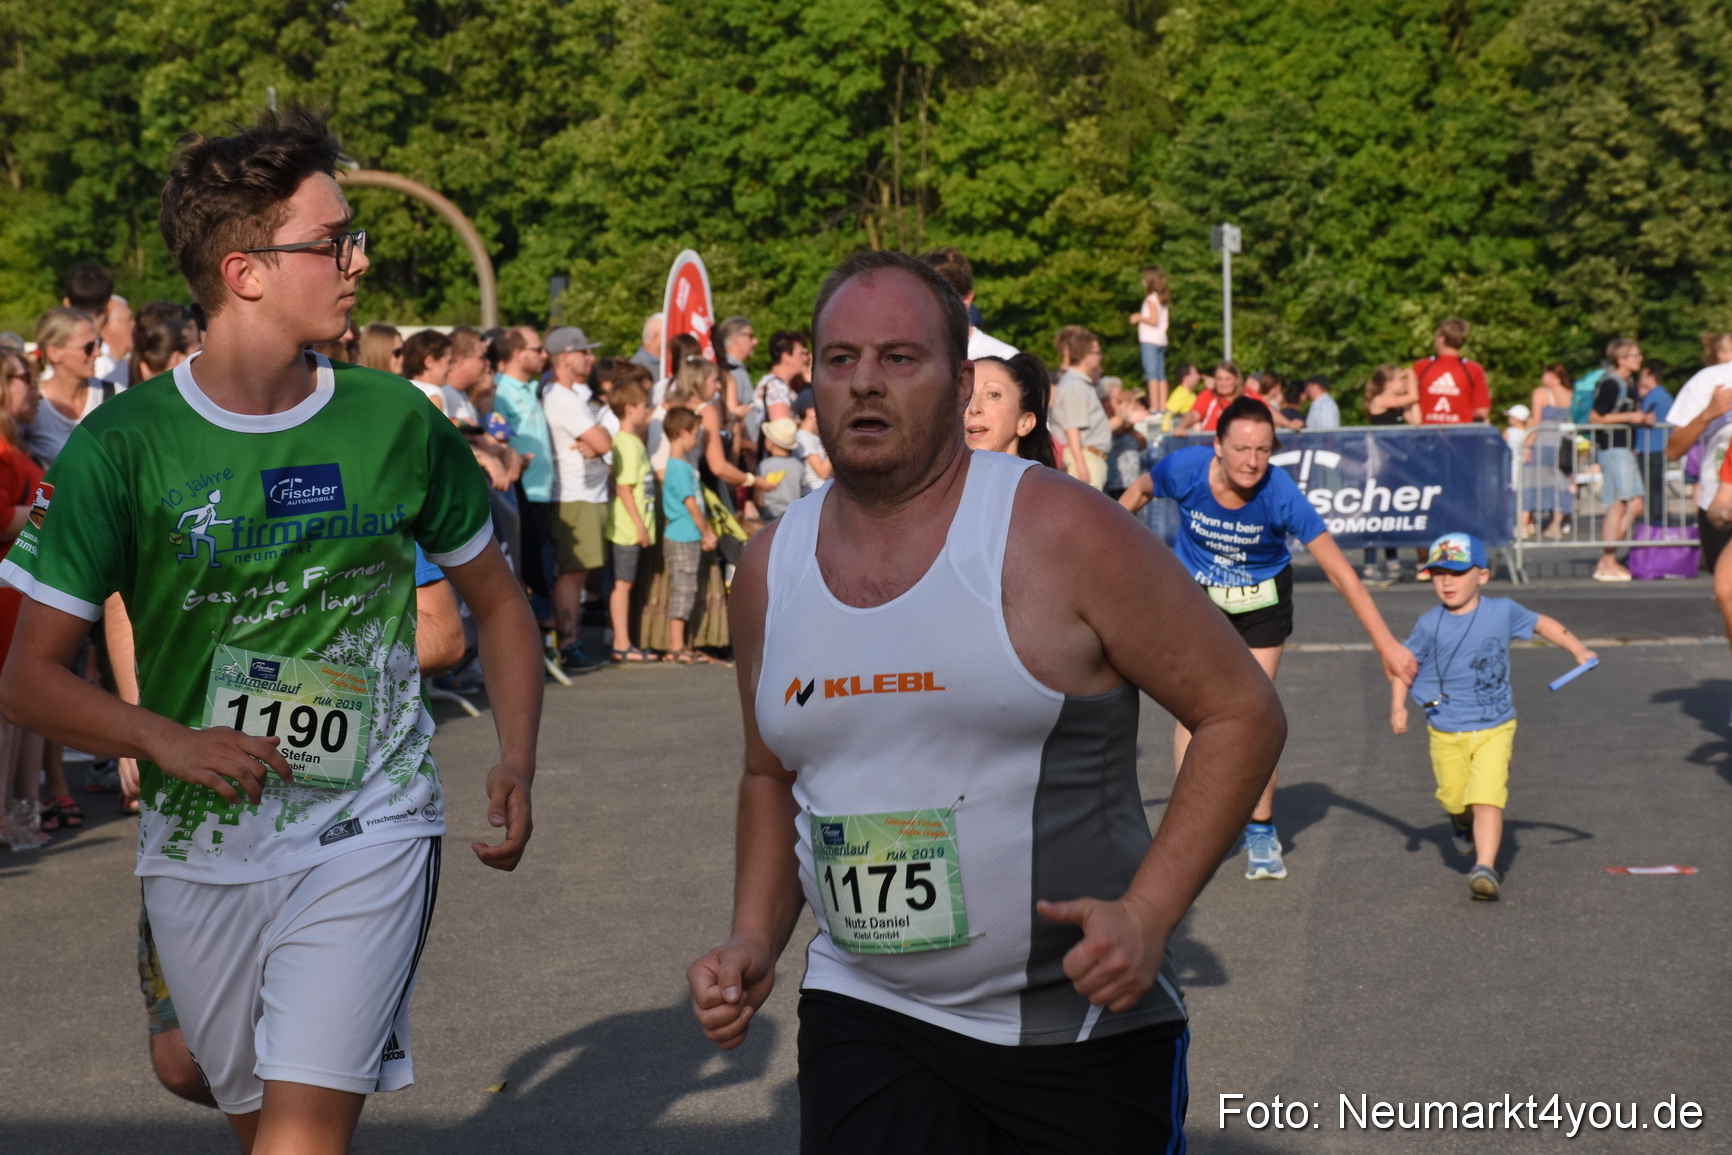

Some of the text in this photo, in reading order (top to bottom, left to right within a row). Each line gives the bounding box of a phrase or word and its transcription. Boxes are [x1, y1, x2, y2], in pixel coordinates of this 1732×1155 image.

[161, 467, 234, 509] 10 Jahre
[281, 485, 339, 501] Fischer
[1298, 478, 1442, 515] scher
[287, 495, 335, 506] AUTOMOBILE
[231, 504, 406, 550] firmenlauf
[1190, 509, 1264, 533] Wenn es beim
[1323, 515, 1428, 535] OMOBILE
[1190, 520, 1261, 545] Hausverkauf
[234, 542, 313, 564] neumarkt
[183, 560, 385, 611] Gesunde Firmen
[228, 573, 393, 625] aufen länger!
[236, 673, 303, 694] firmenlauf
[824, 671, 946, 699] KLEBL
[313, 695, 363, 710] run 2019
[228, 694, 348, 753] 1190
[281, 748, 321, 764] Stefan
[366, 813, 408, 827] Frischmann
[325, 824, 349, 839] AOK
[887, 847, 945, 861] run 2019
[824, 862, 937, 914] 1175
[844, 915, 910, 929] Nutz Daniel
[873, 930, 899, 940] GmbH
[382, 1050, 405, 1062] didas
